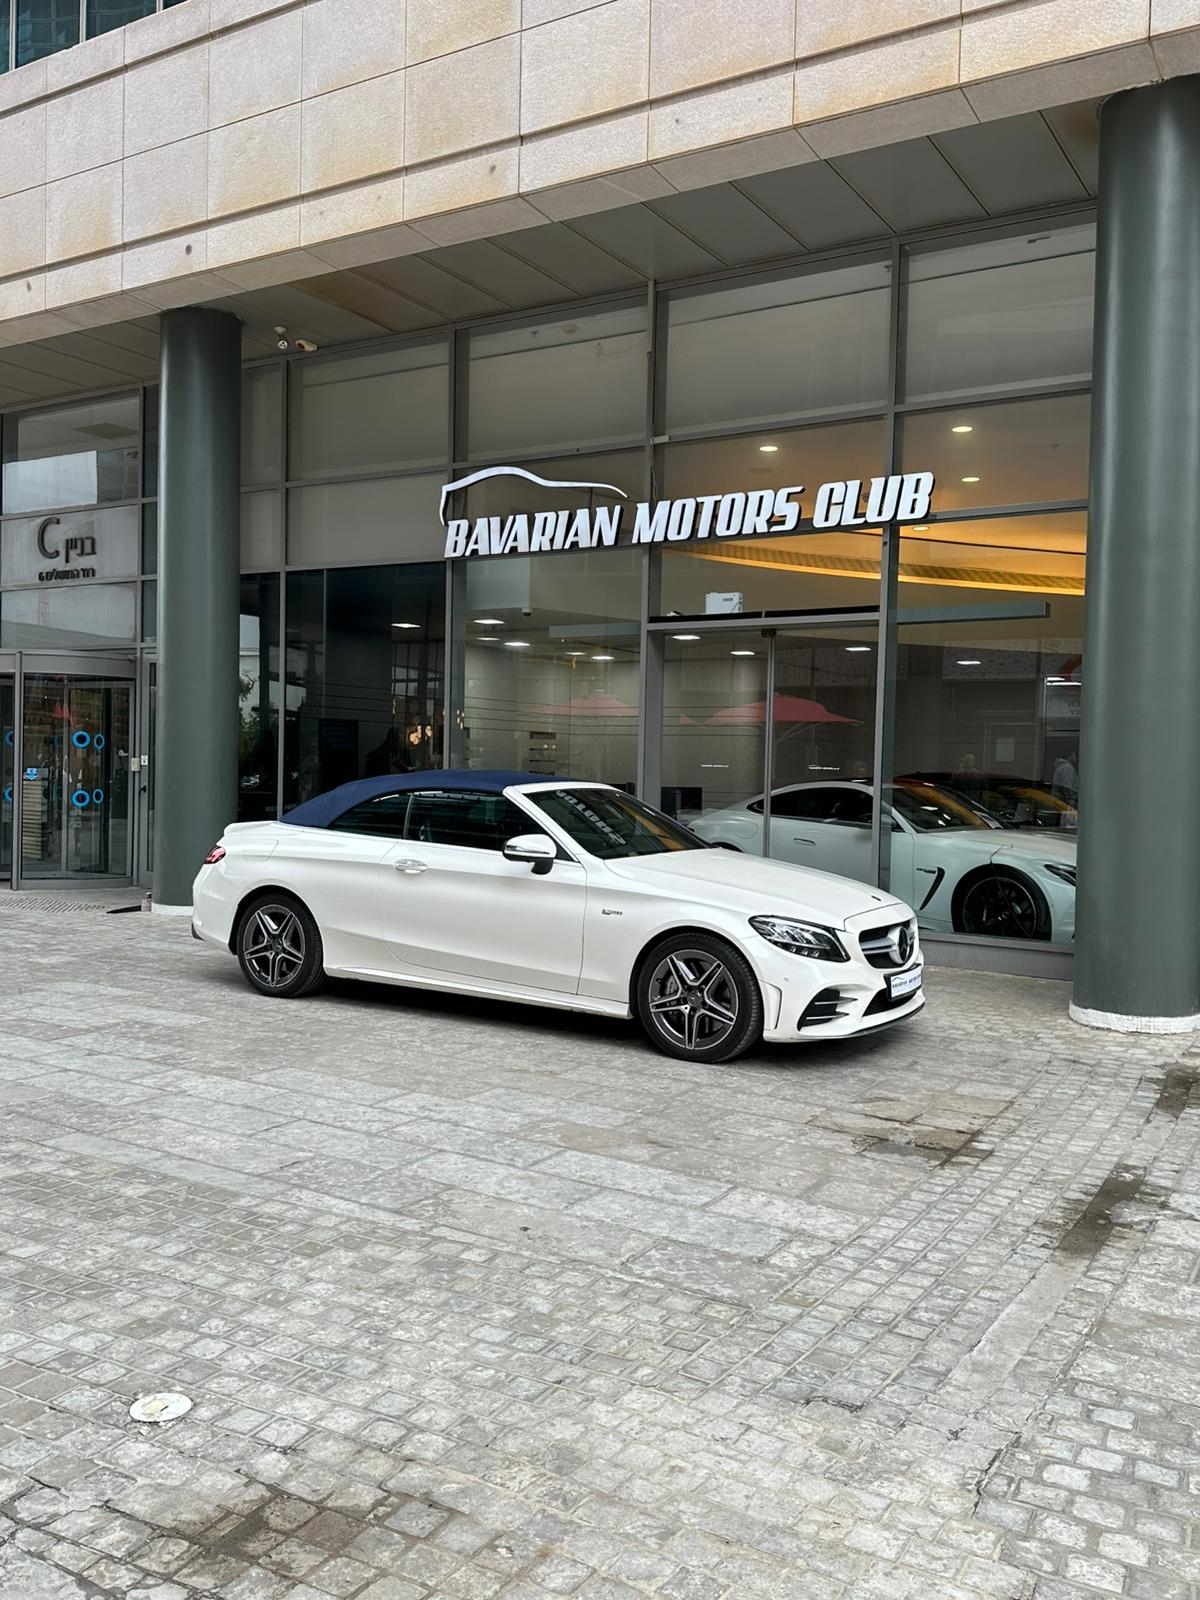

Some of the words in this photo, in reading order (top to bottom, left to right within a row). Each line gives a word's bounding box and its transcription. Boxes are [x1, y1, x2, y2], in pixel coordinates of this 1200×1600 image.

[444, 504, 622, 558] BAVARIAN
[632, 486, 804, 544] MOTORS
[813, 472, 934, 528] CLUB
[38, 517, 60, 559] C
[65, 536, 96, 563] בניין
